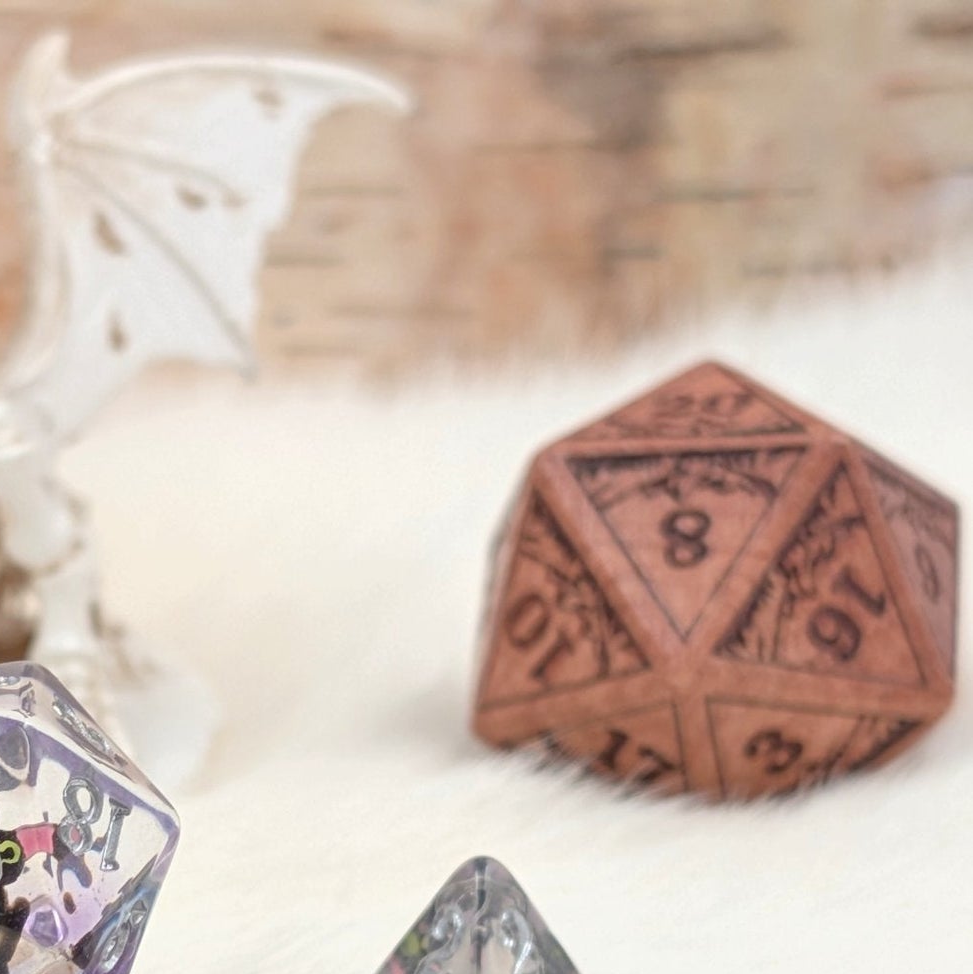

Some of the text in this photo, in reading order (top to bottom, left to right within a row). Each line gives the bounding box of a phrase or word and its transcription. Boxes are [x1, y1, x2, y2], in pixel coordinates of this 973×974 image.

[660, 508, 712, 570] 8
[505, 592, 575, 682] 10
[806, 565, 887, 663] 16
[743, 727, 805, 776] 3
[56, 776, 134, 873] 18
